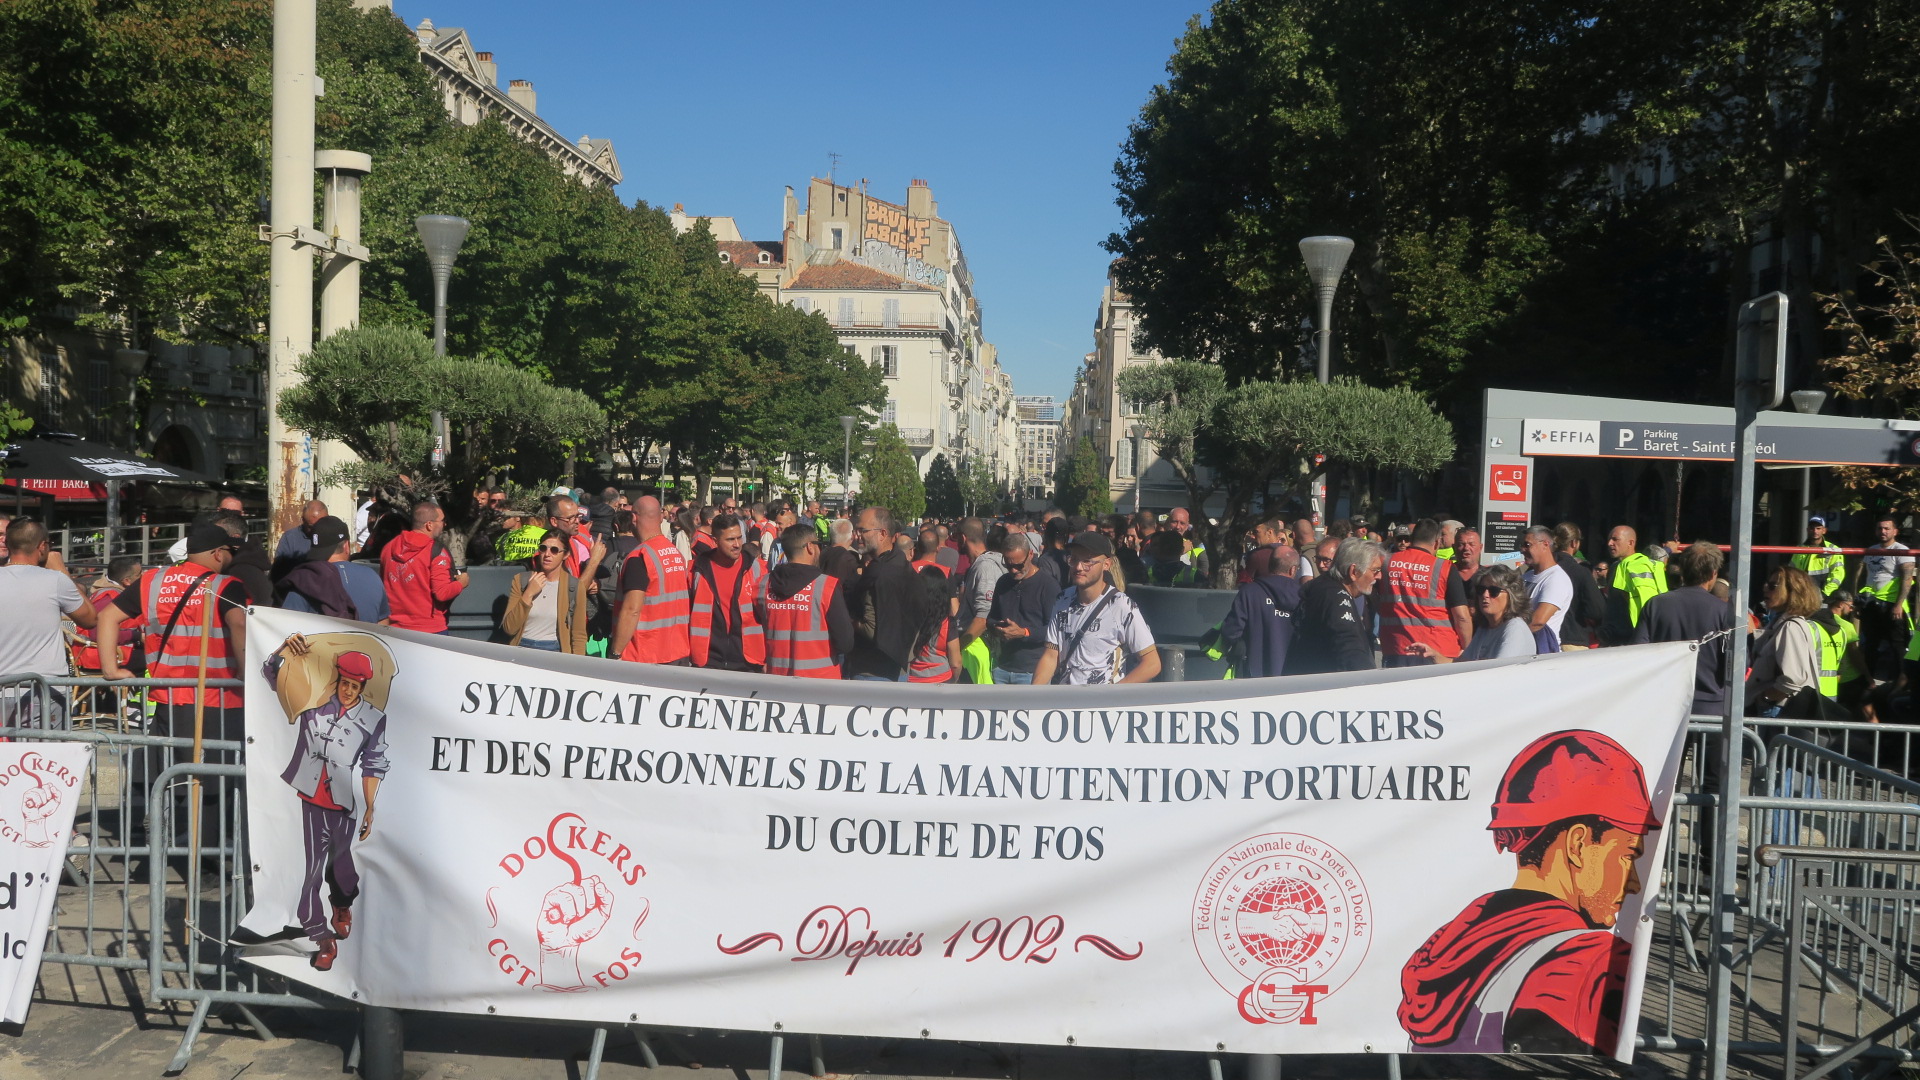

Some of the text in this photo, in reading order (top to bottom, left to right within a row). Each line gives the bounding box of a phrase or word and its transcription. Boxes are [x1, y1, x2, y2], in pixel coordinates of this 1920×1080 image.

[866, 200, 931, 247] BRUME
[1550, 430, 1595, 444] EFFIA
[1619, 428, 1635, 448] P
[1643, 429, 1678, 441] Parking
[1643, 439, 1680, 453] Baret
[1692, 440, 1726, 454] Saint
[1388, 570, 1403, 578] CGT
[1413, 573, 1429, 582] EDC
[1390, 560, 1430, 572] DOCKERS
[793, 593, 811, 602] EDC
[1414, 582, 1427, 590] FOS
[767, 602, 787, 610] GOLFE
[460, 681, 1445, 746] SYNDICAT GÉNÉRAL C.G.T. DES OUVRIERS DOCKERS
[429, 736, 1472, 803] ET DES PERSONNELS DE LA MANUTENTION PORTUAIRE
[499, 812, 647, 886] DOCKERS
[764, 814, 1105, 861] DU GOLFE DE FOS
[1274, 862, 1292, 871] ET
[1197, 838, 1367, 937] Fédération Nationale des Ports et Docks
[791, 904, 1065, 976] Depuis 1902
[488, 938, 535, 986] CGT
[592, 947, 642, 988] FOS
[1237, 966, 1329, 1025] CGT
